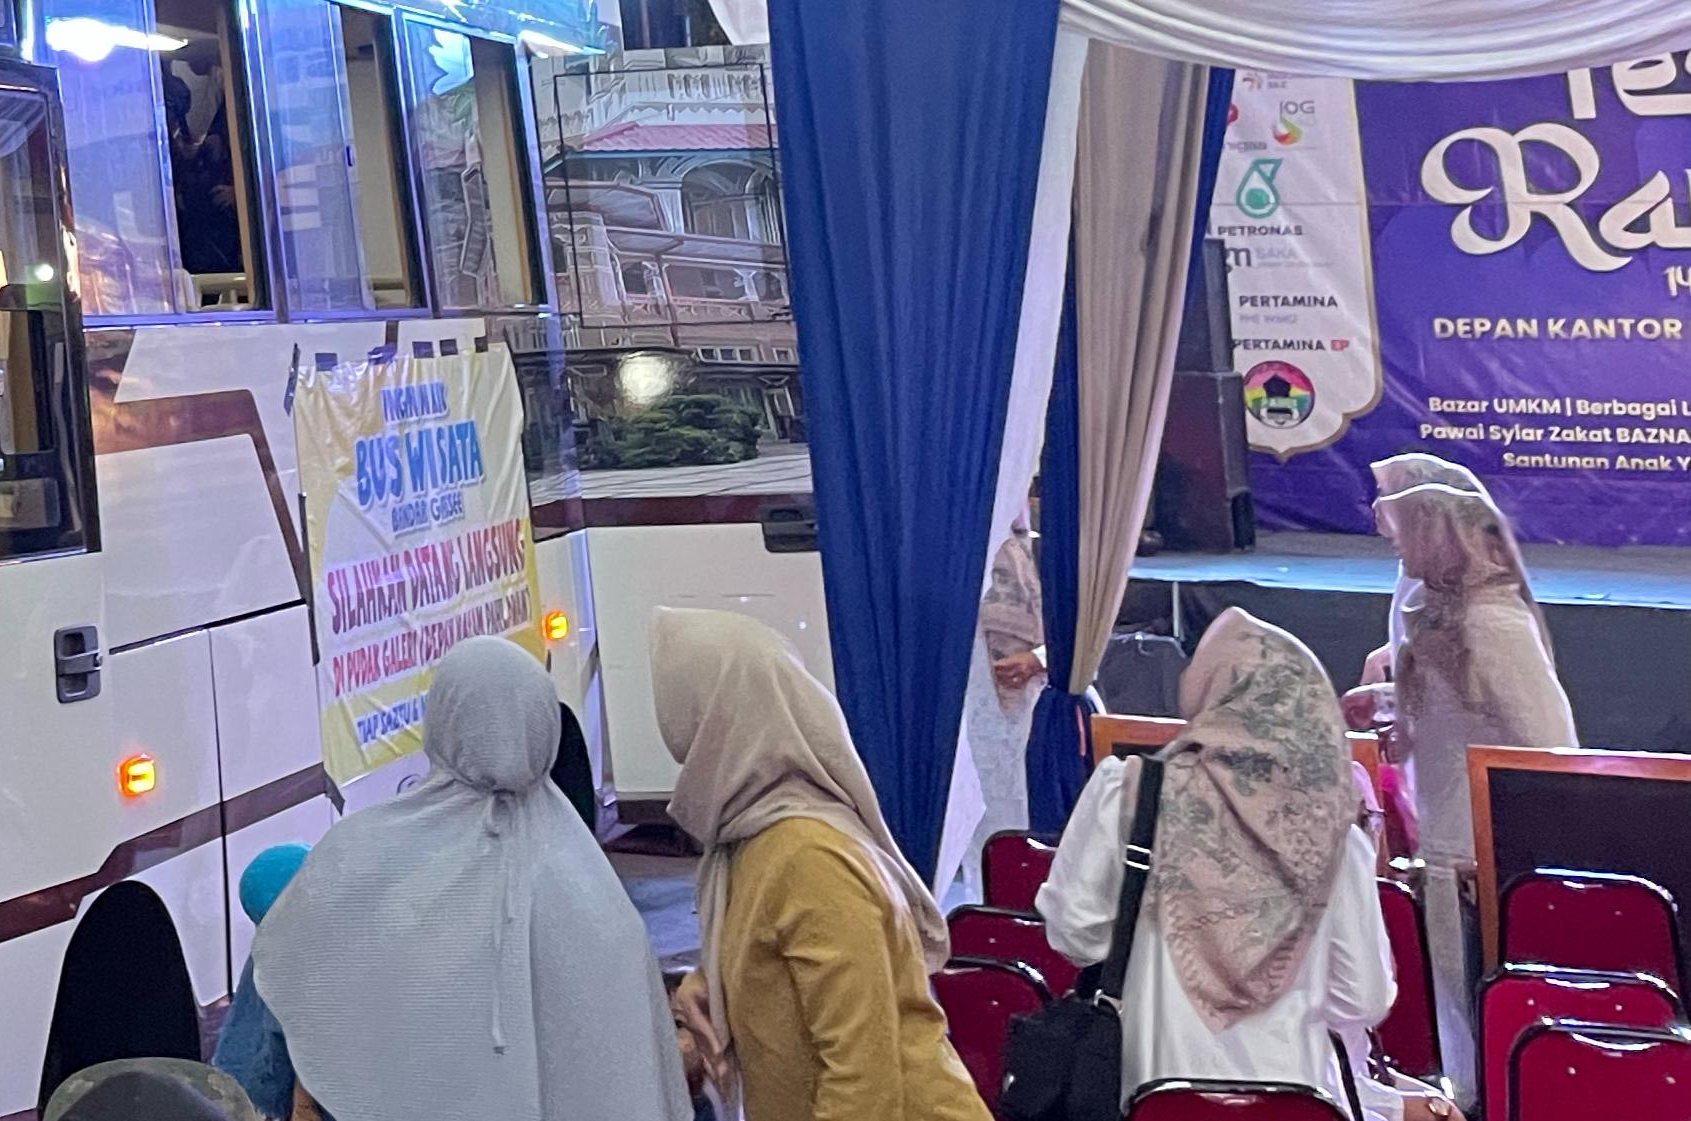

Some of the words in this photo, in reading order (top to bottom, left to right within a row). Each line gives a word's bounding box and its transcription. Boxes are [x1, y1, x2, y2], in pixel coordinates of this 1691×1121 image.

[1421, 123, 1691, 272] Ra
[1218, 225, 1303, 236] PETRONAS
[1239, 295, 1338, 308] PERTAMINA
[1433, 317, 1539, 340] DEPAN
[1547, 317, 1683, 340] KANTOR
[1232, 338, 1326, 351] PERTAMINA
[1428, 396, 1489, 413] Bazar
[1493, 398, 1562, 415] UMKM
[1576, 398, 1678, 421] Berbagai
[1420, 423, 1485, 440] Pawai
[1489, 424, 1544, 446] Syiar
[1549, 426, 1613, 443] Zakat
[356, 433, 403, 507] BUS
[405, 420, 484, 493] WISATA
[1503, 452, 1610, 471] Santunan
[1615, 454, 1673, 472] Anak
